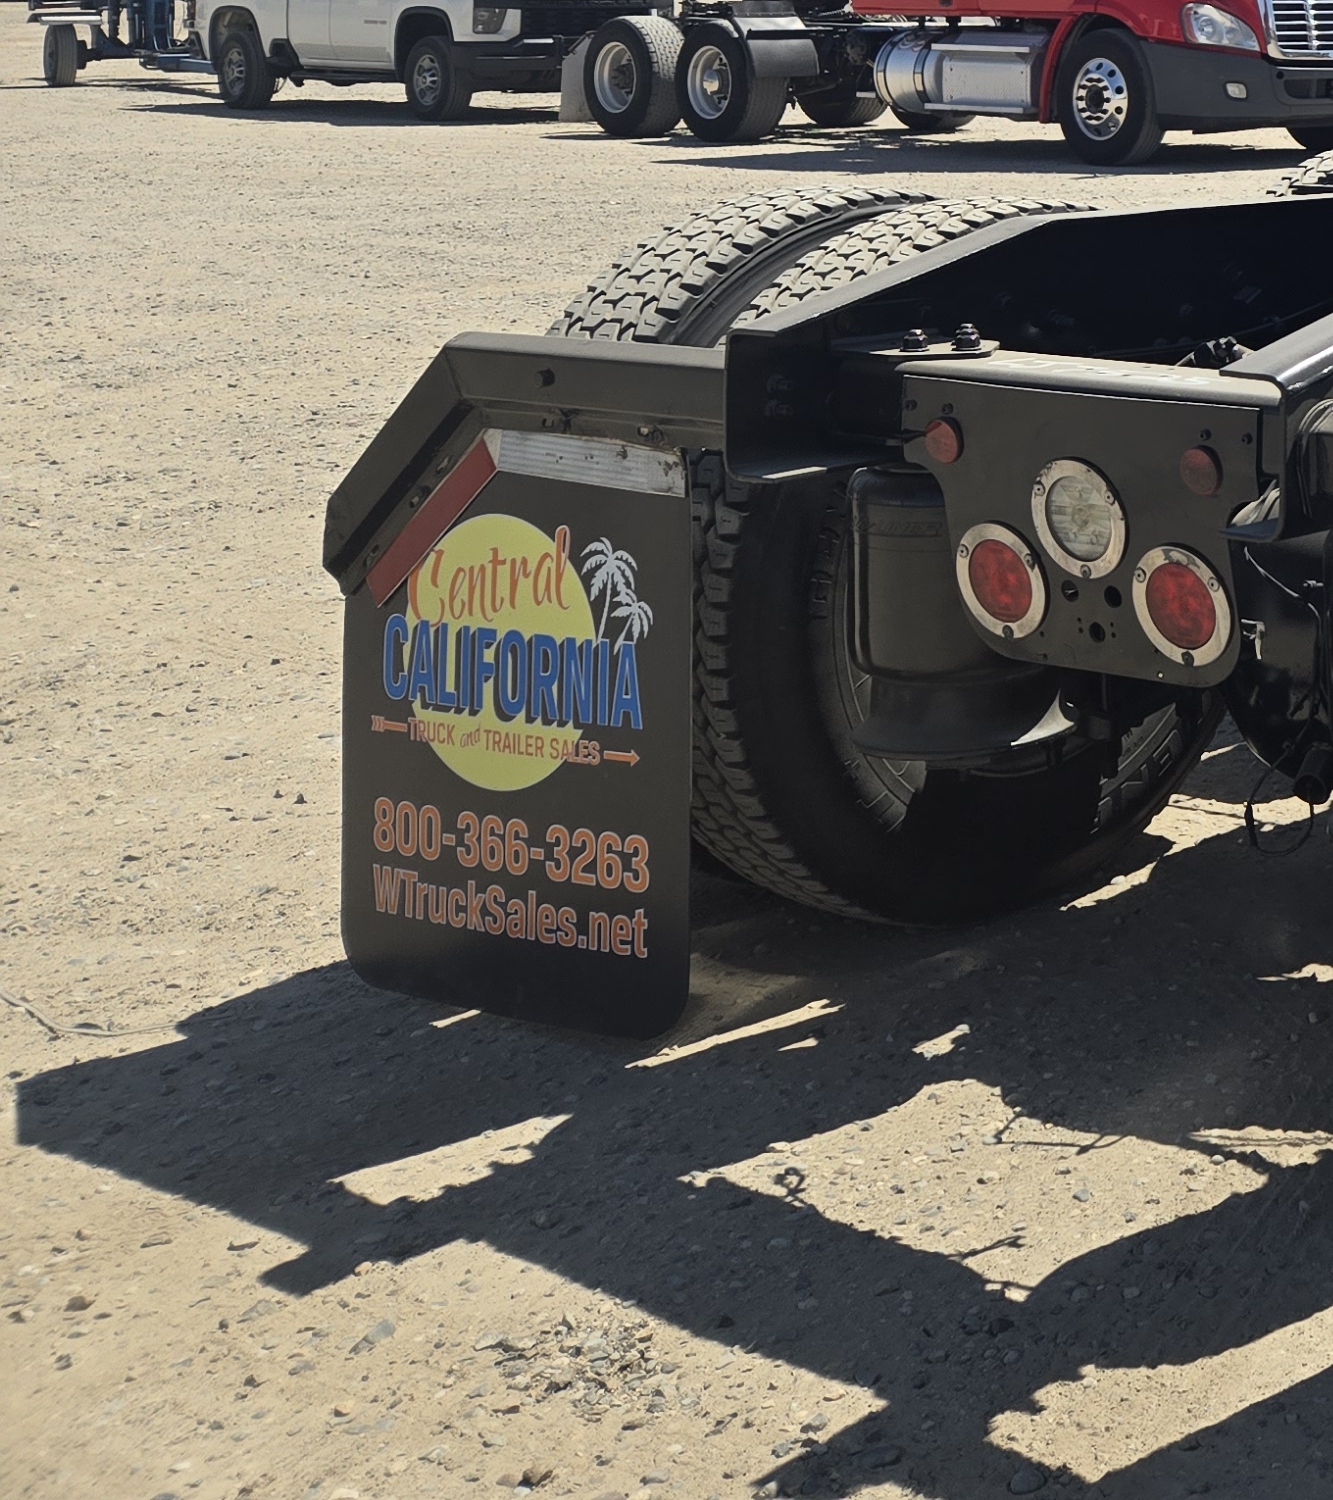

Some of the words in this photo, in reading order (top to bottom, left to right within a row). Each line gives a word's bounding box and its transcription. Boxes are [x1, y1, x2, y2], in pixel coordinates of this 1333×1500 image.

[408, 524, 572, 628] Central
[382, 612, 643, 731] CALIFORNIA
[407, 717, 456, 746] TRUCK
[460, 722, 482, 749] and
[483, 728, 545, 758] TRAILER
[549, 736, 601, 766] SALES
[373, 797, 650, 894] 800-366-3263
[372, 862, 649, 959] WTruckSales.net
